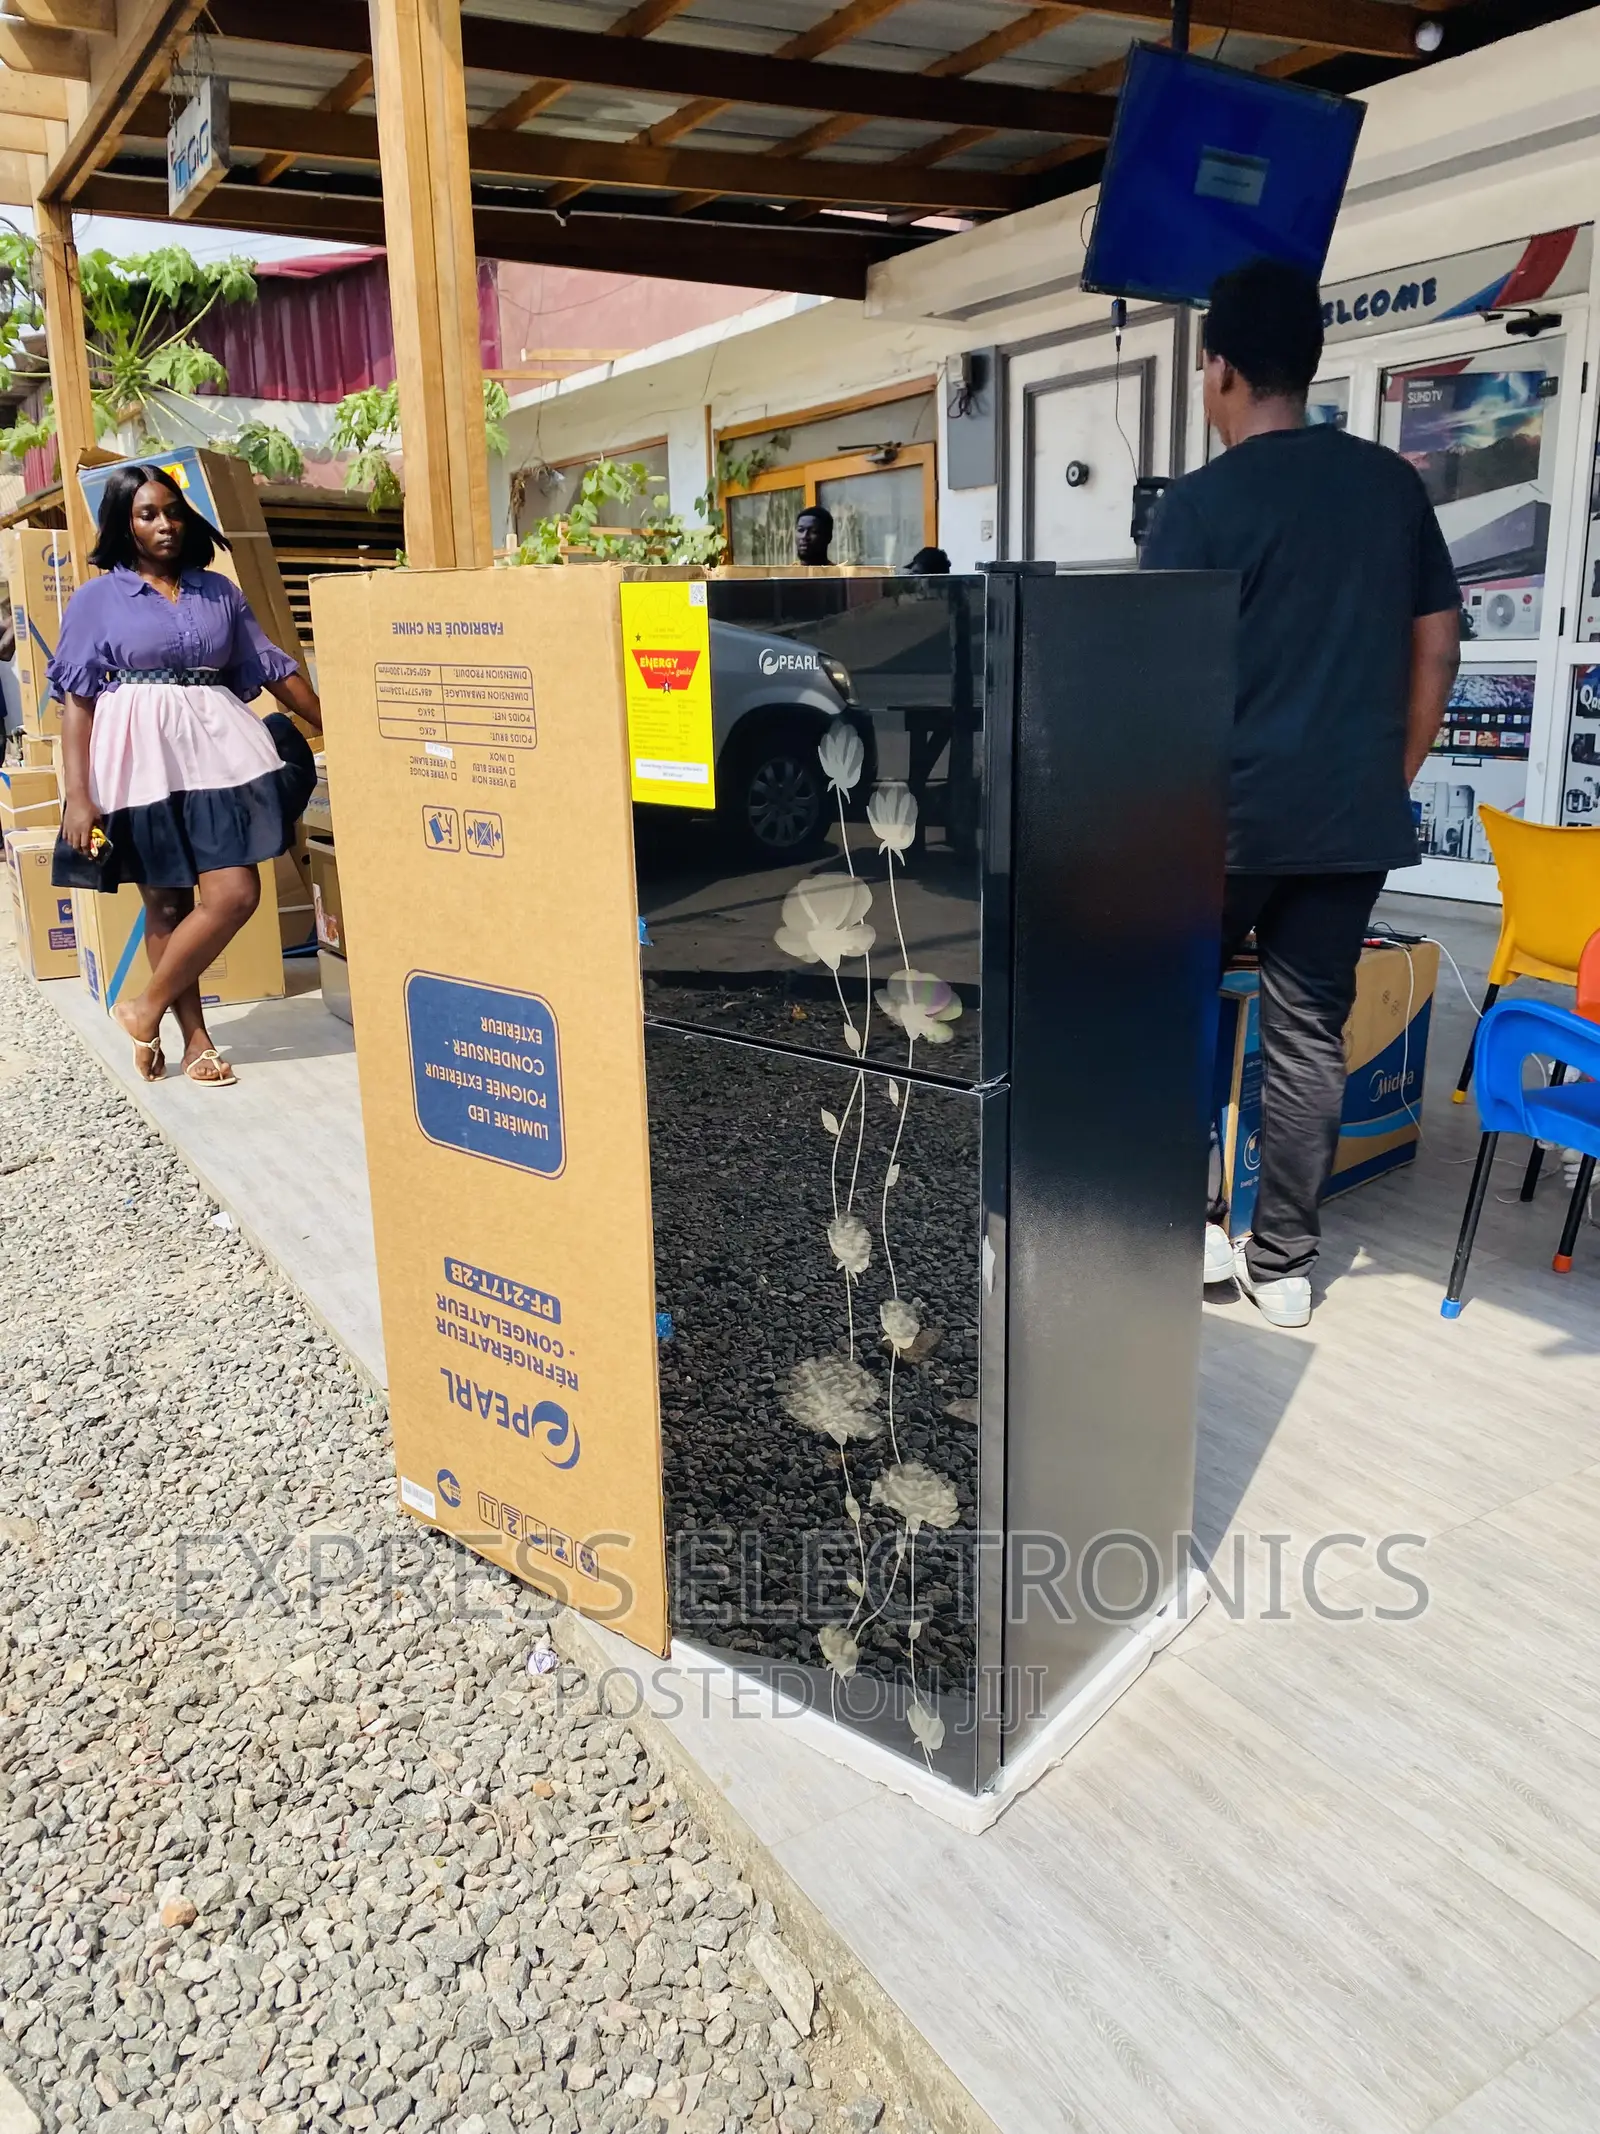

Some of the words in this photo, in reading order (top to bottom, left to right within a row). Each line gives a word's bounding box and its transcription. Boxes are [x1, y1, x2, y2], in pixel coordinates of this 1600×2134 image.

[1320, 276, 1437, 329] ELCOME
[1432, 389, 1443, 402] TV
[391, 621, 424, 635] CHINE
[427, 621, 442, 635] EN
[444, 620, 504, 638] FABRIQUÉ
[639, 655, 679, 671] ENERGY
[779, 654, 820, 670] PEARL
[486, 670, 528, 680] DIMENSION
[487, 691, 529, 701] DIMENSION
[508, 713, 531, 723] POIDS
[418, 726, 437, 736] 42KG
[510, 733, 532, 744] POIDS
[409, 755, 428, 766] BLANC
[429, 758, 448, 768] VERRE
[489, 752, 507, 763] INOX
[409, 767, 429, 778] ROUGE
[430, 770, 449, 780] VERRE
[472, 763, 487, 773] BLEU
[488, 765, 507, 775] VERRE
[471, 775, 488, 785] NOIR
[489, 777, 509, 788] VERRE
[480, 1016, 543, 1045] EXTÉRIEUR
[452, 1038, 545, 1076] CONDENSUER
[424, 1062, 482, 1091] EXTÉRIEUR
[486, 1078, 547, 1109] POIGNÉE
[467, 1104, 491, 1125] LED
[493, 1111, 549, 1141] LUMIÈRE
[450, 1262, 554, 1319] PF-217T-2B
[435, 1292, 564, 1359] CONGELATEUR
[435, 1316, 579, 1392] RÉFRIGÉRATEUR
[440, 1366, 530, 1439] PEARL
